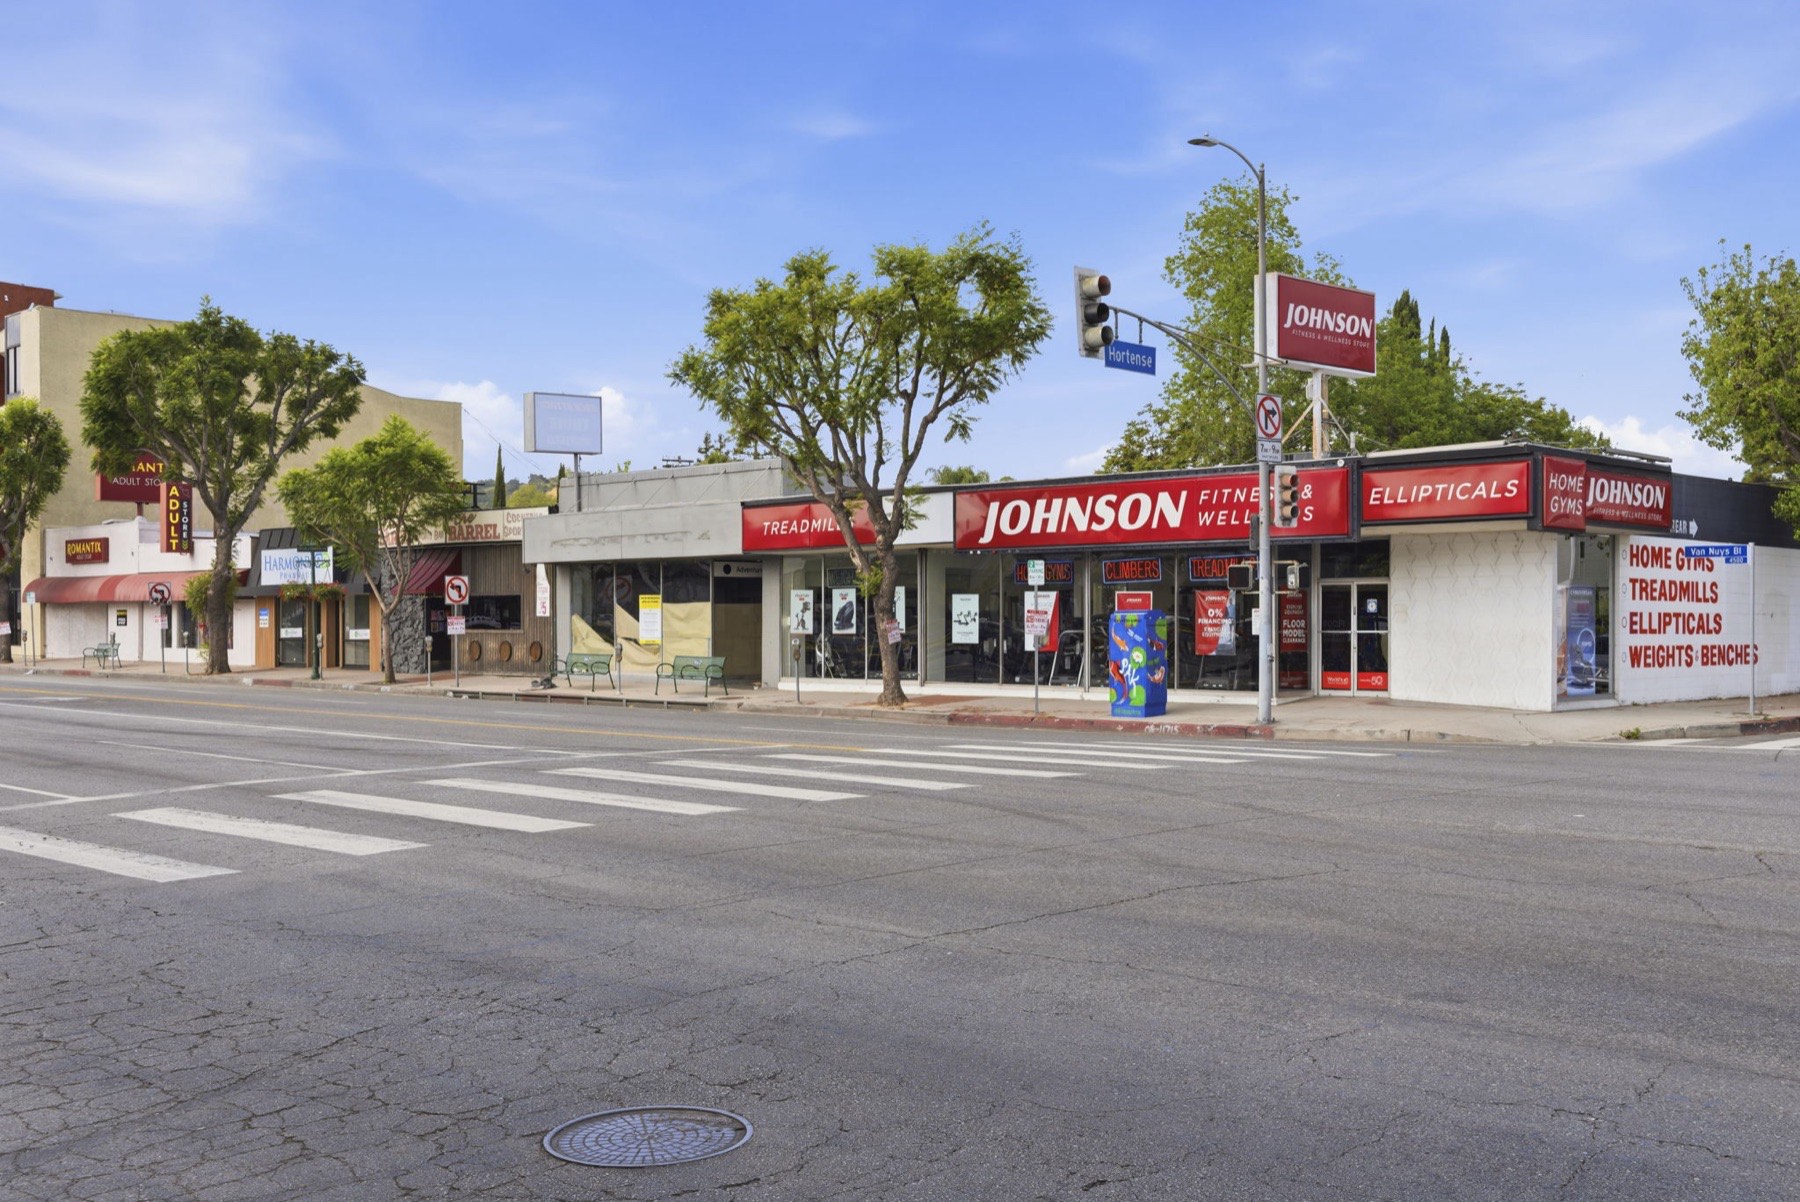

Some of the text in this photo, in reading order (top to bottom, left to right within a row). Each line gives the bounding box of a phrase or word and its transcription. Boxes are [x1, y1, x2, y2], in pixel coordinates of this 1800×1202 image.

[1283, 303, 1373, 338] JOHNSON
[1292, 329, 1316, 339] FITNESS
[1323, 335, 1351, 345] WELLNESS
[1353, 340, 1370, 349] STORE
[1108, 345, 1153, 368] Hortense
[112, 477, 161, 487] ADULT STO
[1301, 483, 1313, 499] &
[1368, 479, 1520, 505] ELLIPTICALS
[1549, 472, 1584, 493] HOME
[1586, 477, 1665, 510] JOHNSON
[1198, 506, 1315, 526] WELLS
[1550, 495, 1583, 516] GYMS
[169, 485, 180, 551] ADULT
[763, 516, 855, 537] TREADMIL
[978, 490, 1187, 544] JOHNSON
[448, 523, 500, 541] BARREL
[67, 541, 102, 556] ROMANTIX
[1629, 545, 1671, 569] HOME
[1690, 547, 1706, 556] Van
[1708, 547, 1730, 558] Nuys
[264, 554, 311, 571] HARMON
[1104, 561, 1160, 579] CLIMBERS
[1629, 578, 1718, 603] TREADMILLS
[1208, 608, 1224, 618] 0%
[1283, 619, 1306, 628] FLOOR
[1629, 612, 1722, 634] ELLIPTICALS
[1283, 629, 1306, 638] MODEL
[1629, 644, 1693, 668] WEIGHTS
[1701, 644, 1758, 667] BENCHES
